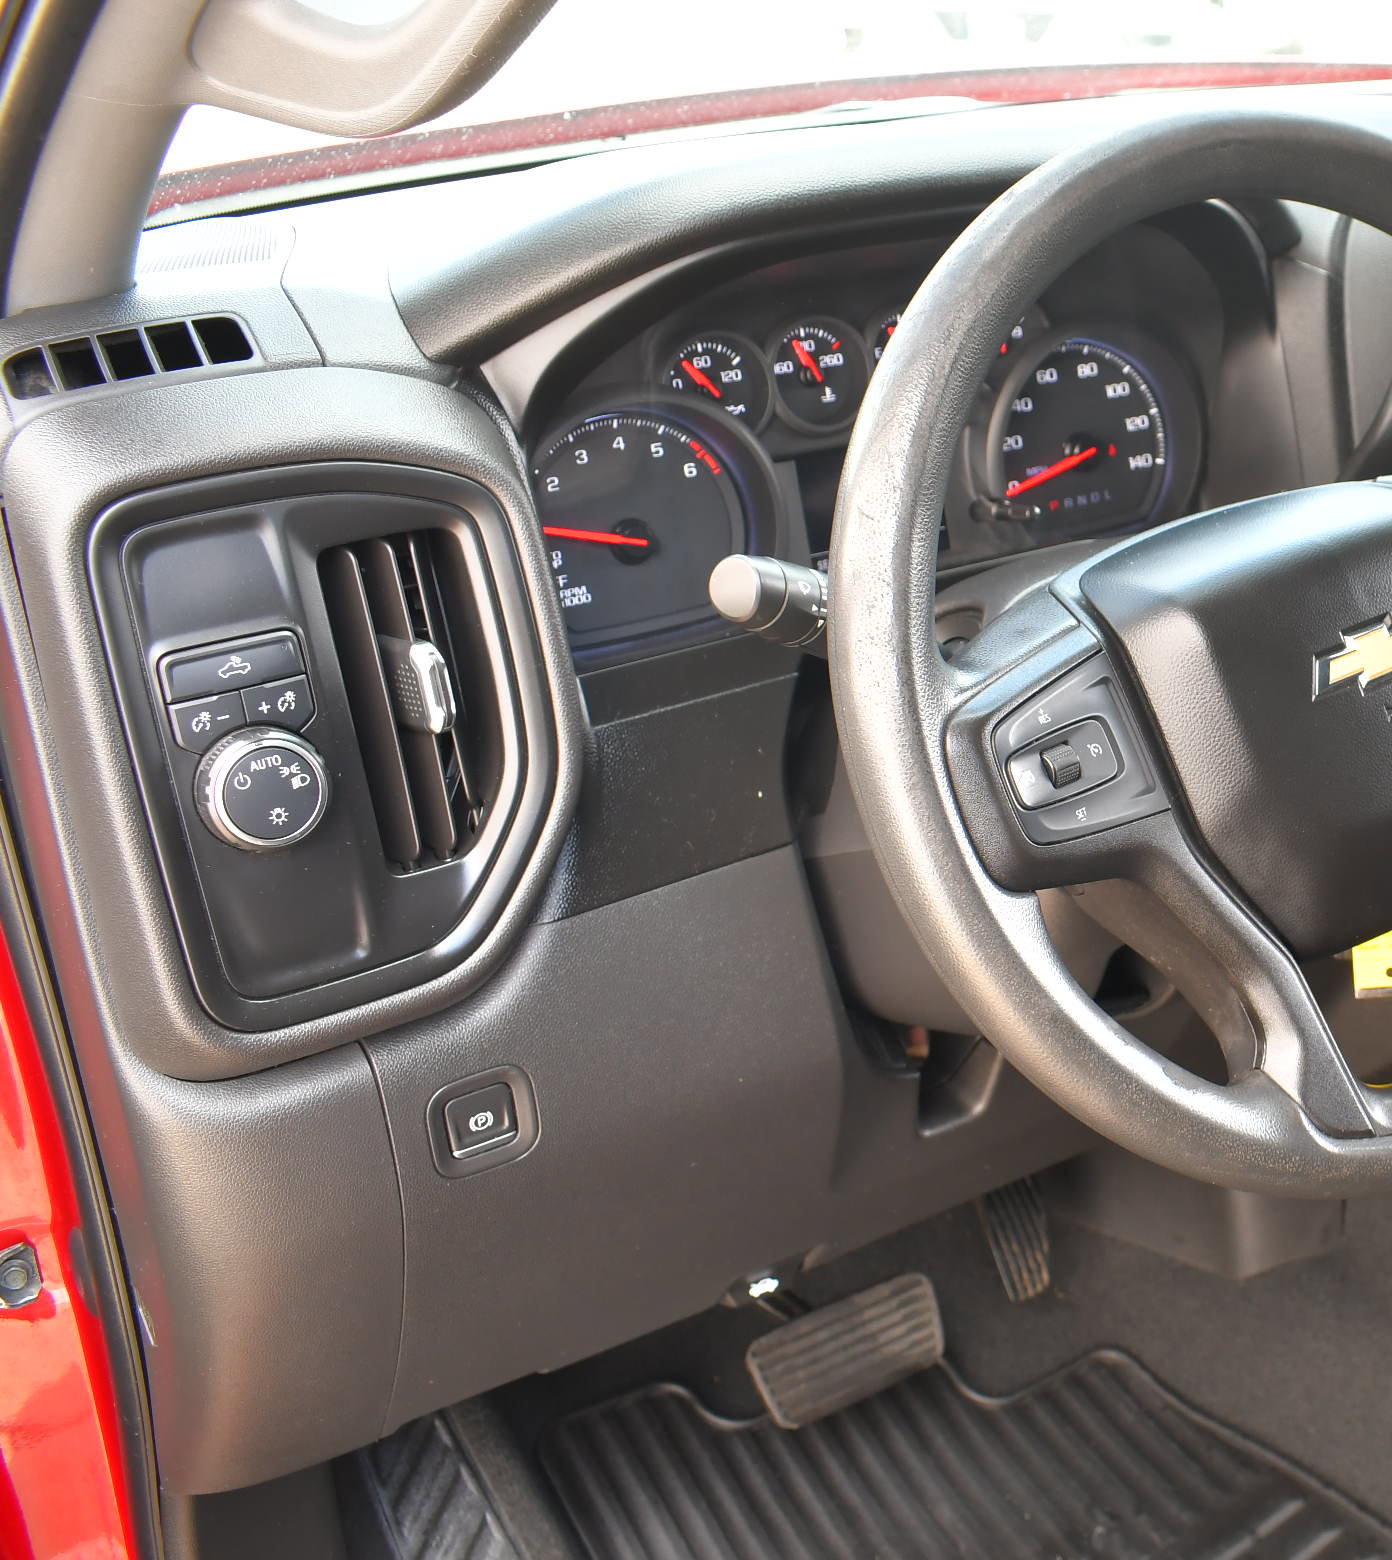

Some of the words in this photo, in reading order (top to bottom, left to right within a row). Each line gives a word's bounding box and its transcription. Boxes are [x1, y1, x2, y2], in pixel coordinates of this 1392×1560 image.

[693, 355, 712, 369] 60
[819, 352, 844, 369] 260
[720, 368, 743, 384] 120
[1036, 367, 1058, 385] 60
[1077, 361, 1099, 379] 80
[1105, 381, 1131, 400] 100
[1011, 397, 1033, 413] 40
[1124, 414, 1150, 433] 120
[612, 436, 626, 451] 4
[650, 442, 665, 458] 5
[1002, 434, 1023, 452] 20
[574, 449, 589, 465] 3
[1128, 452, 1154, 471] 140
[683, 462, 698, 479] 6
[546, 476, 560, 493] 2
[559, 585, 588, 600] RPM
[1038, 713, 1052, 725] RES
[250, 754, 282, 772] AUTO
[1075, 806, 1088, 820] SET
